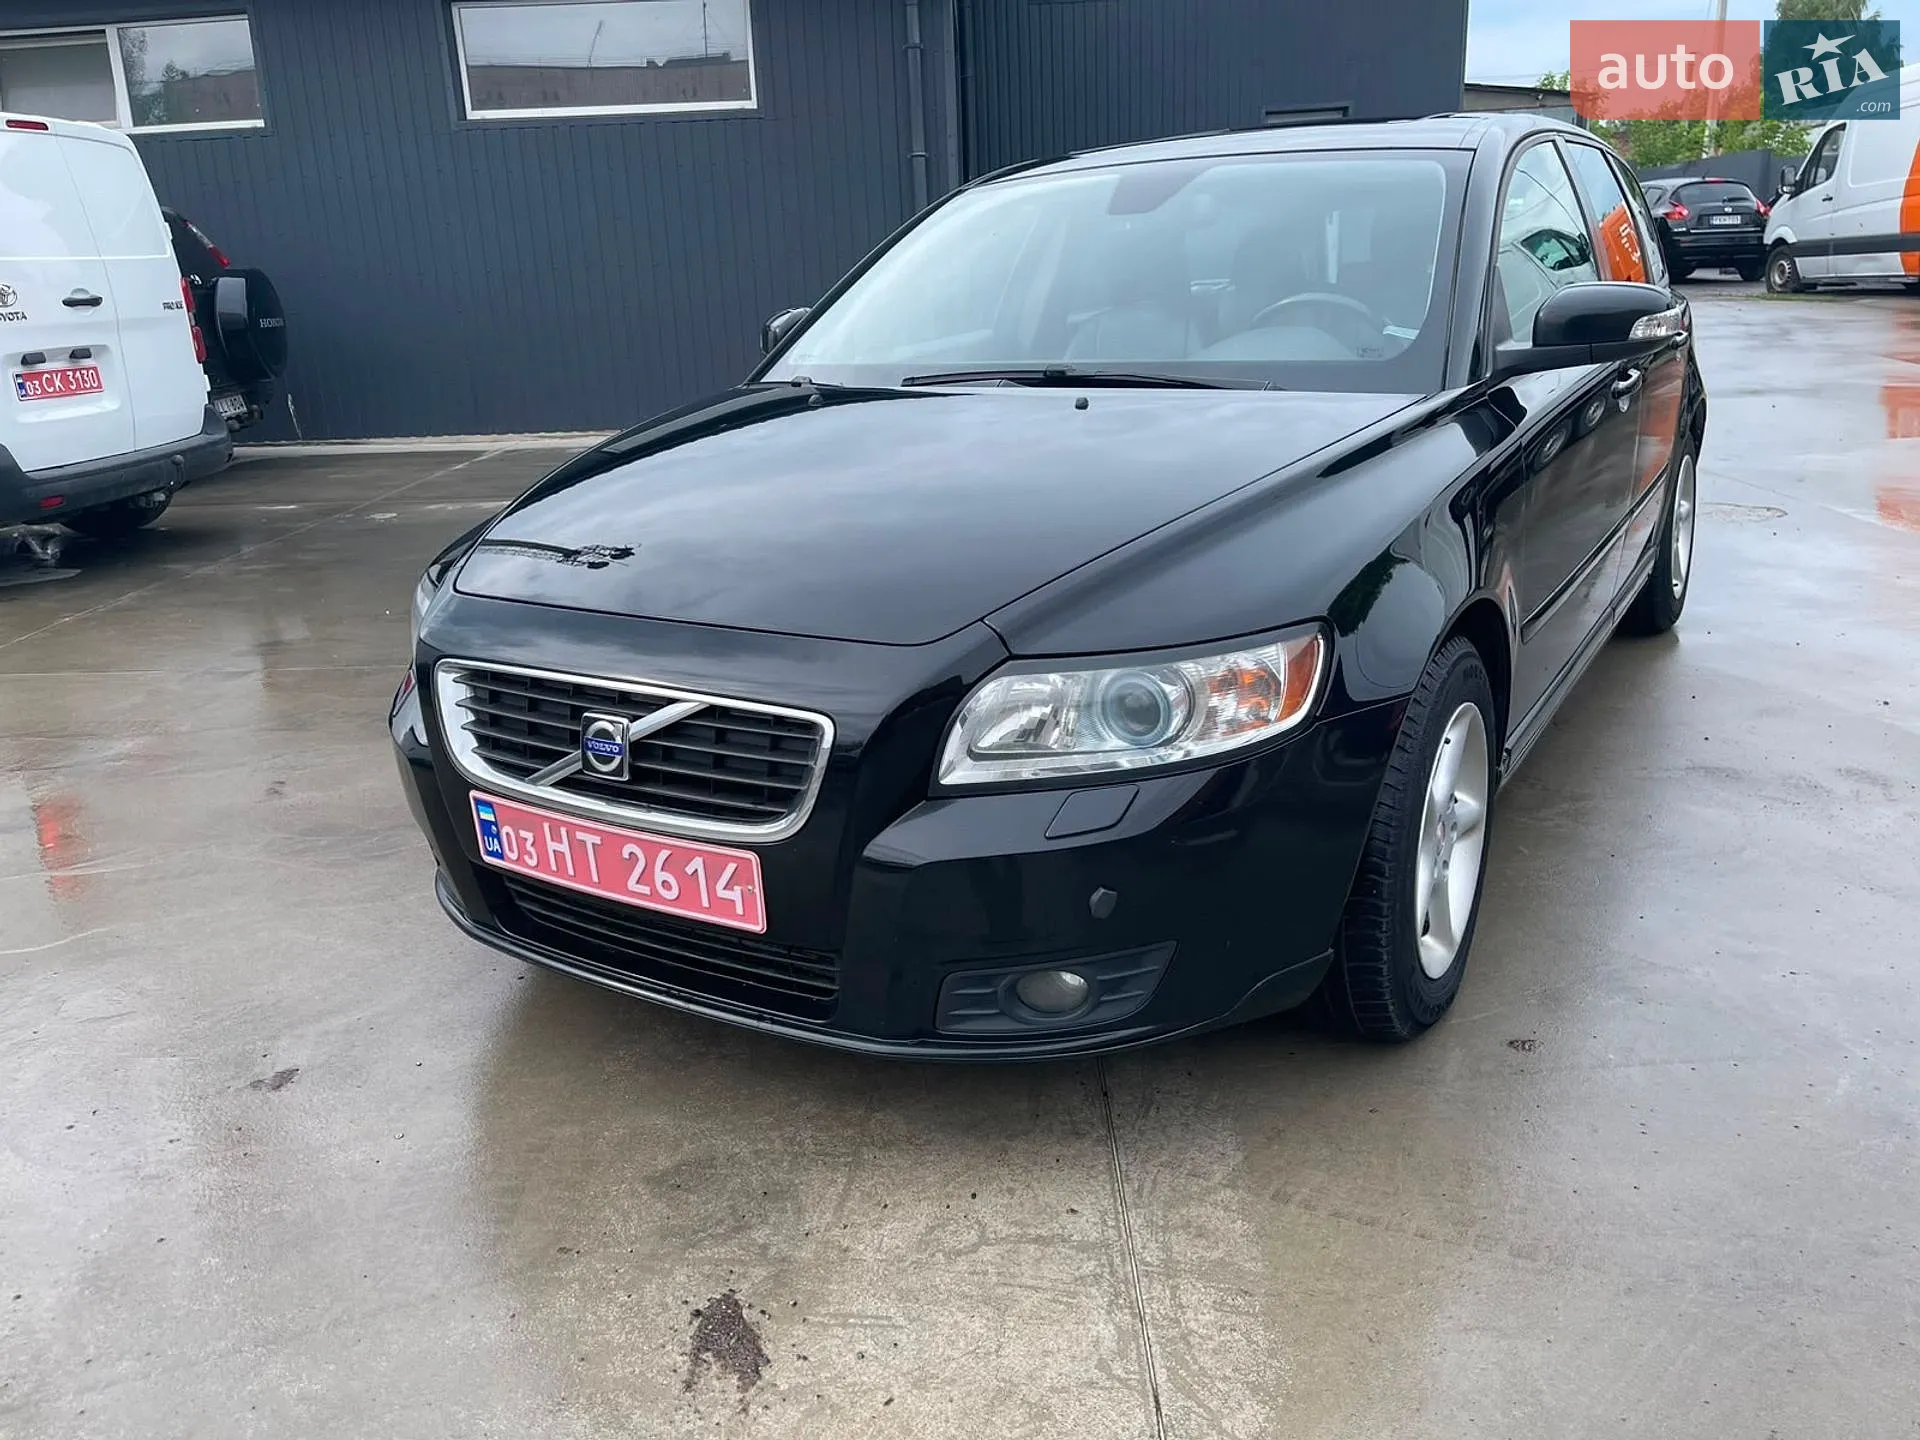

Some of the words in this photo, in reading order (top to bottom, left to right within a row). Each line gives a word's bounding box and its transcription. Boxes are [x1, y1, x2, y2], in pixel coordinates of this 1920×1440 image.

[26, 380, 42, 396] 03
[42, 373, 65, 393] CK
[66, 369, 98, 390] 3130
[587, 740, 620, 753] VOLVO
[484, 835, 502, 854] UA
[501, 825, 539, 867] 03
[543, 822, 601, 883] HT
[621, 843, 744, 916] 2614
